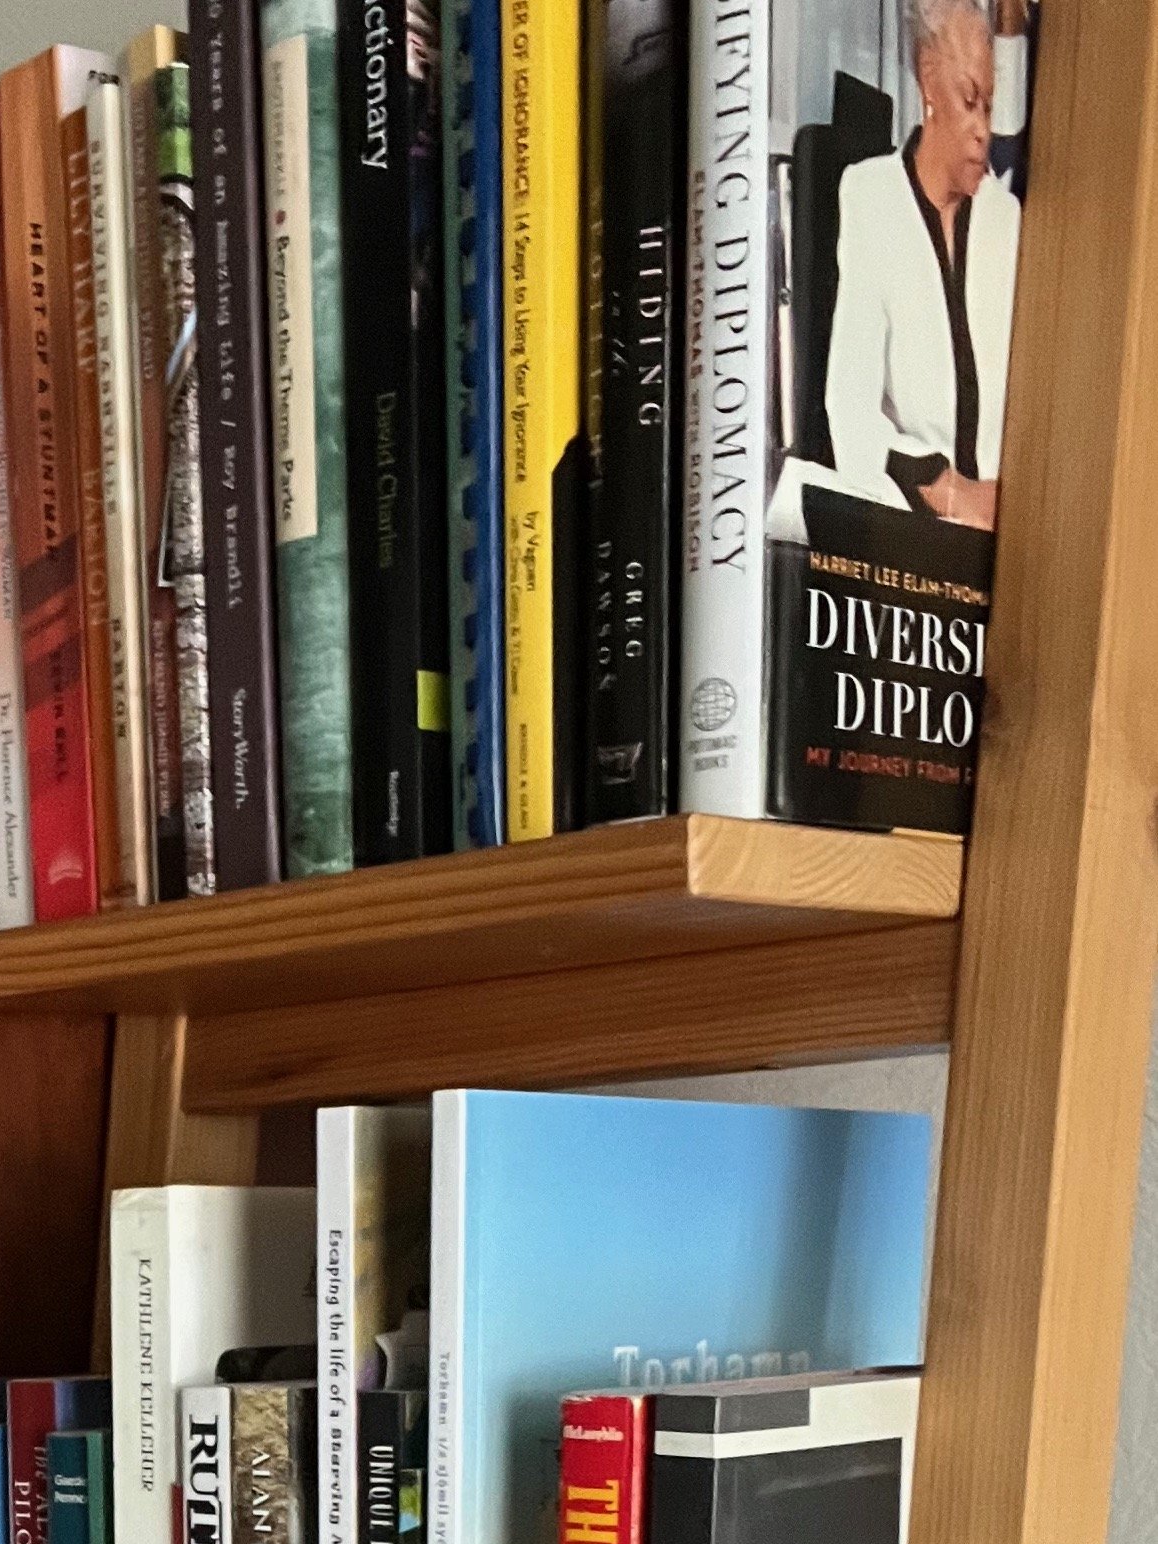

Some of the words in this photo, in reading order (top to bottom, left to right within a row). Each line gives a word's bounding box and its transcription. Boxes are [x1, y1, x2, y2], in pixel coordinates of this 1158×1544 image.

[360, 0, 394, 170] ctionary
[512, 33, 531, 61] OF
[212, 128, 229, 158] of
[713, 0, 750, 210] IFYING
[68, 148, 92, 241] LILY
[89, 139, 111, 320] SURVIVING
[213, 175, 228, 204] an
[514, 212, 532, 232] 14
[29, 223, 48, 317] HEART
[268, 235, 290, 322] Beyond
[511, 236, 532, 282] Steps
[514, 286, 531, 305] to
[689, 170, 706, 380] ELAM-THOMAS
[34, 329, 49, 365] OF
[72, 261, 96, 374] HARP
[276, 328, 294, 368] the
[511, 309, 532, 356] Using
[638, 225, 664, 427] HIDING
[37, 378, 49, 394] A
[218, 340, 237, 401] Life
[513, 363, 532, 398] Your
[709, 231, 750, 575] DIPLOMACY
[99, 335, 117, 517] NASHVILLE
[276, 373, 295, 453] Theme
[375, 391, 397, 466] David
[510, 402, 532, 483] Ignorance
[39, 408, 60, 563] STUNTMAN
[278, 459, 295, 522] Parks
[376, 474, 399, 568] Charles
[523, 511, 541, 530] by
[688, 453, 701, 574] ROBISON
[81, 468, 112, 626] BARTON
[810, 551, 872, 582] HARRIET
[874, 567, 900, 588] LEE
[597, 540, 617, 691] DAWSON
[625, 561, 645, 659] GREG
[110, 618, 127, 741] BARTON
[833, 671, 974, 748] DIPLO
[0, 729, 18, 805] Florence
[230, 687, 250, 811] StoryWorth.
[805, 746, 831, 766] MY
[838, 750, 909, 778] JOURNEY
[3, 810, 20, 899] Alexander
[325, 1229, 344, 1307] Escaping
[137, 1257, 155, 1375] KATHLENE
[328, 1313, 346, 1342] the
[328, 1348, 347, 1379] life
[329, 1384, 347, 1405] of
[437, 1350, 451, 1426] Torhamn
[138, 1380, 156, 1493] KELLEHER
[329, 1409, 342, 1419] a
[250, 1447, 275, 1534] ALAN
[328, 1426, 344, 1526] Starving
[368, 1444, 395, 1530] UNIQUE
